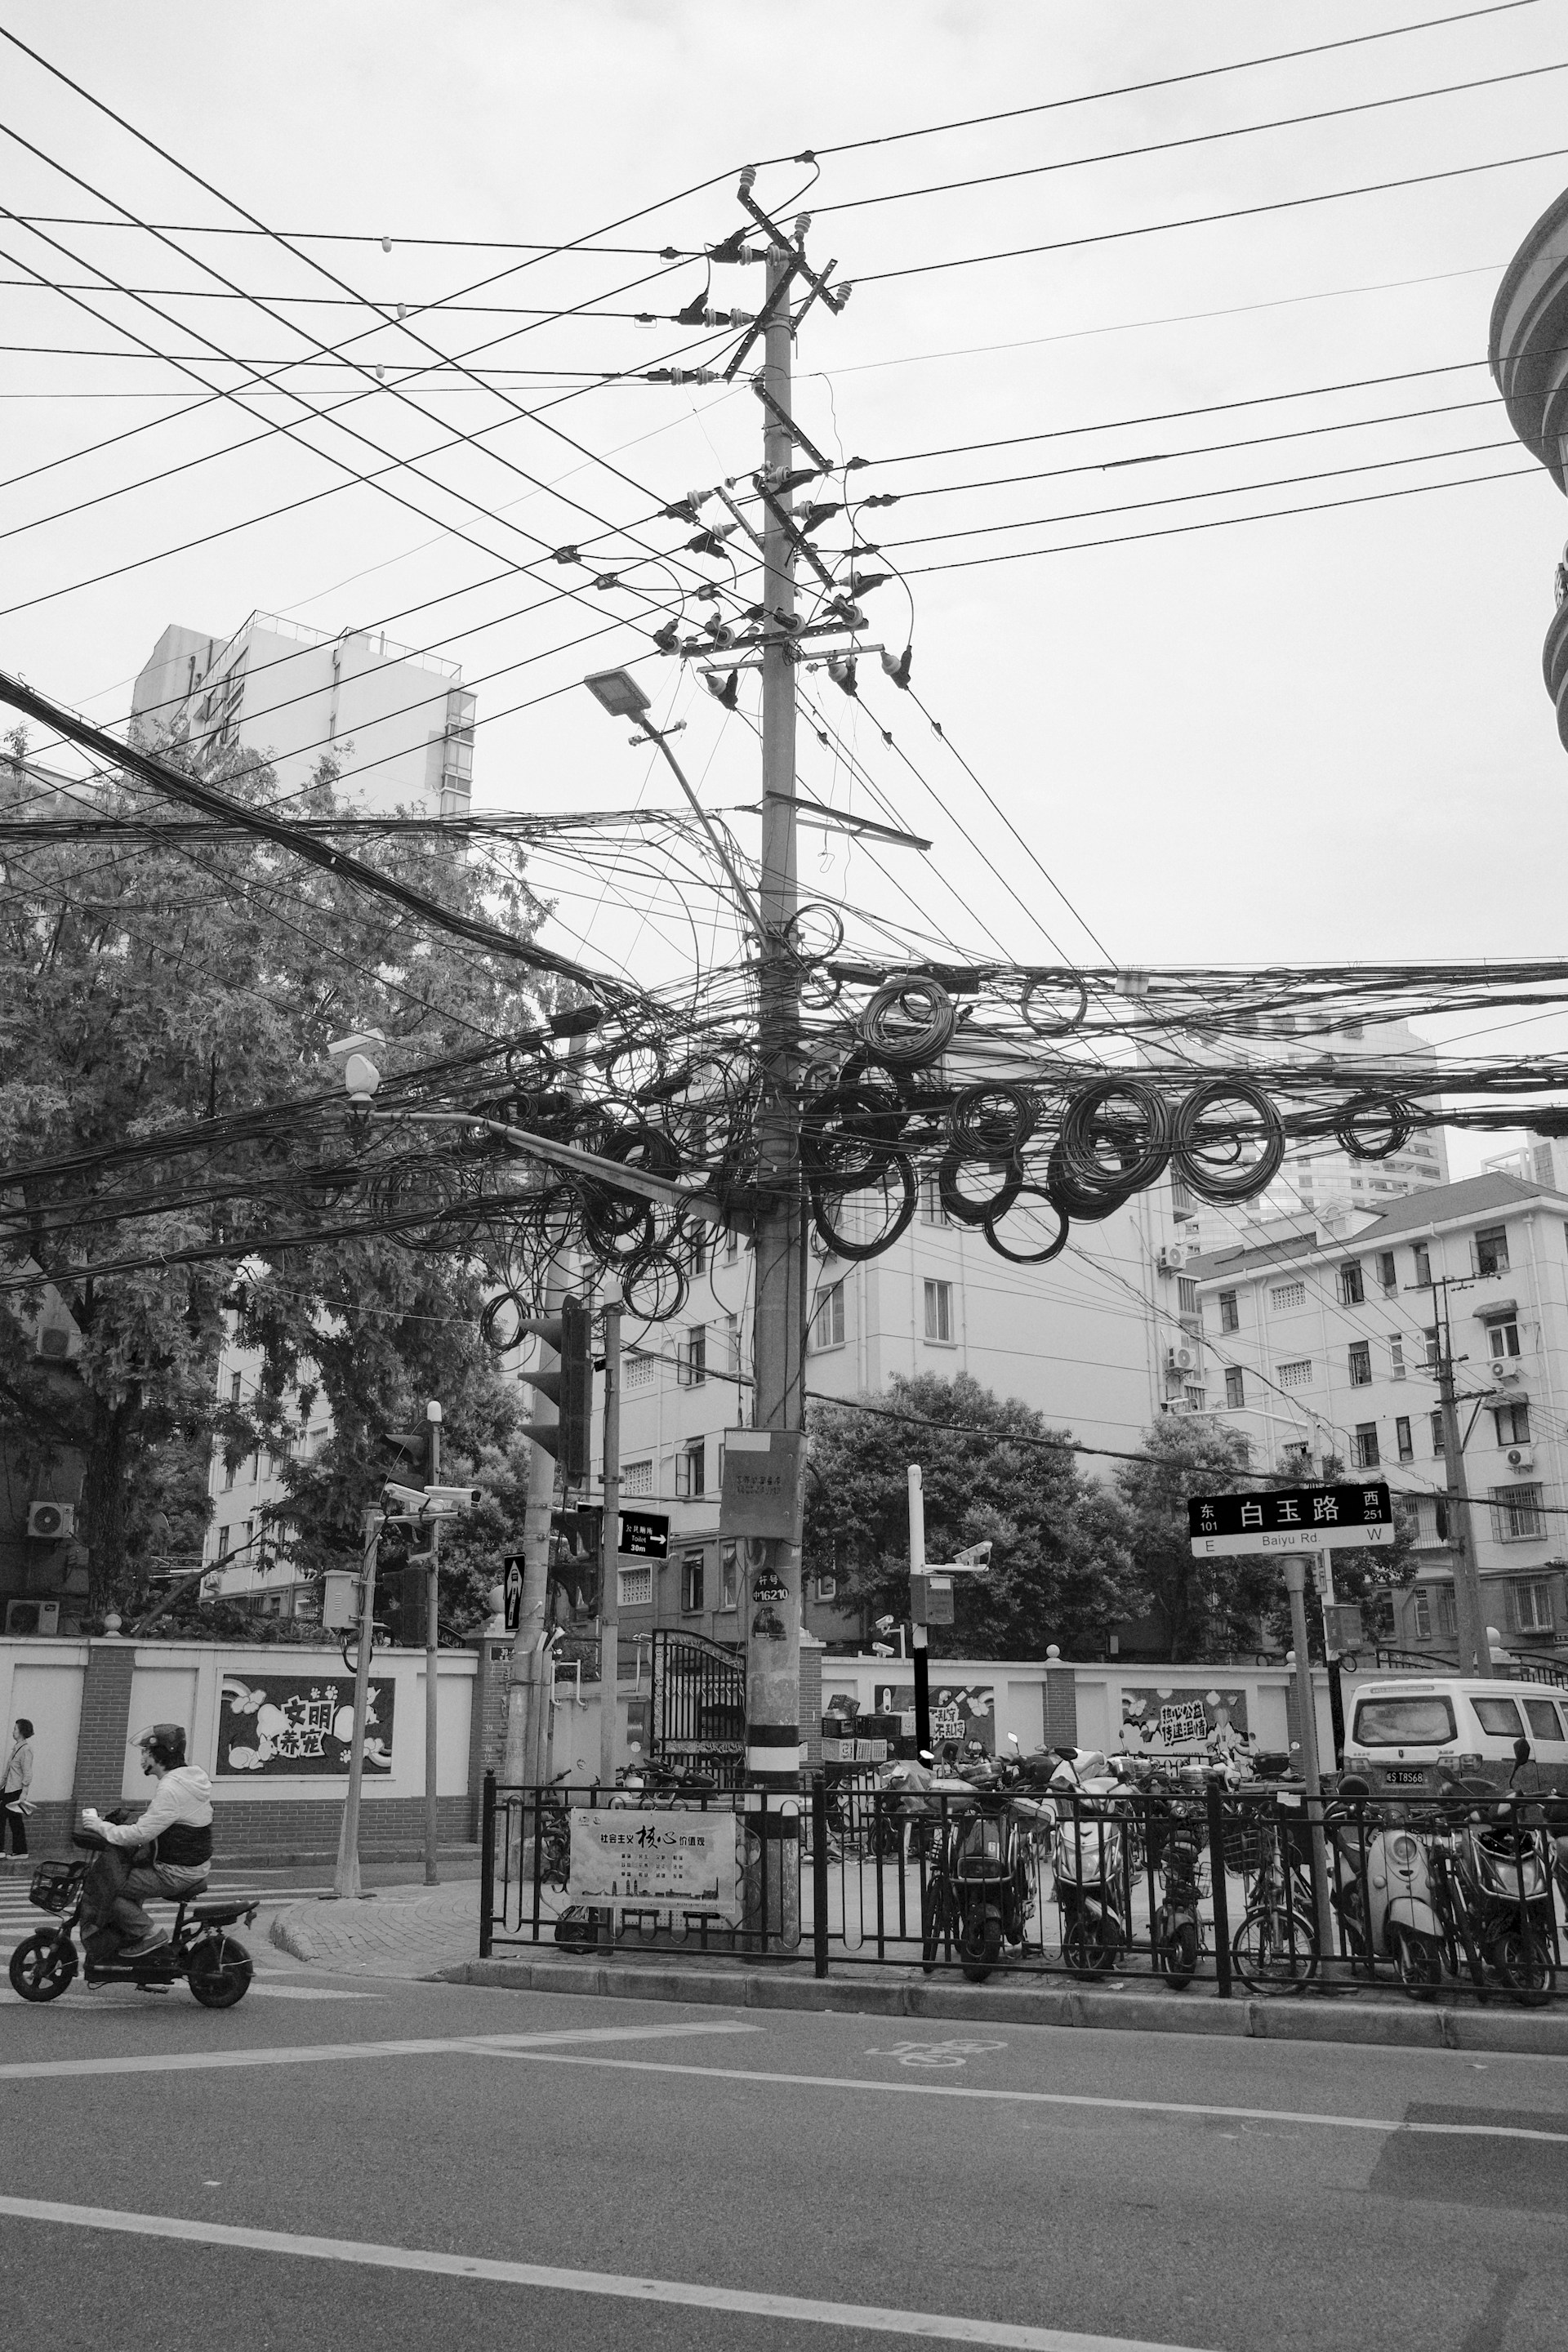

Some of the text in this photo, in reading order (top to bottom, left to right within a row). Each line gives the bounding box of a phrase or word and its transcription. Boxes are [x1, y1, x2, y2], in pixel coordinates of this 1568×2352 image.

[1363, 1490, 1379, 1506] 西
[1200, 1503, 1214, 1519] 东
[1241, 1495, 1339, 1527] 白玉路
[1363, 1510, 1383, 1520] 251
[1200, 1521, 1218, 1531] 101
[1366, 1528, 1382, 1540] W
[1205, 1540, 1215, 1552] E
[1263, 1533, 1321, 1546] Baiyu Rd.
[630, 1544, 646, 1552] 30m
[759, 1575, 778, 1585] 杆号
[284, 1699, 332, 1730] 文明
[1162, 1702, 1204, 1724] 热心公益
[1162, 1718, 1205, 1742] 传递温情
[280, 1728, 323, 1755] 养宠
[600, 1824, 705, 1849] 社会主义核心价值观
